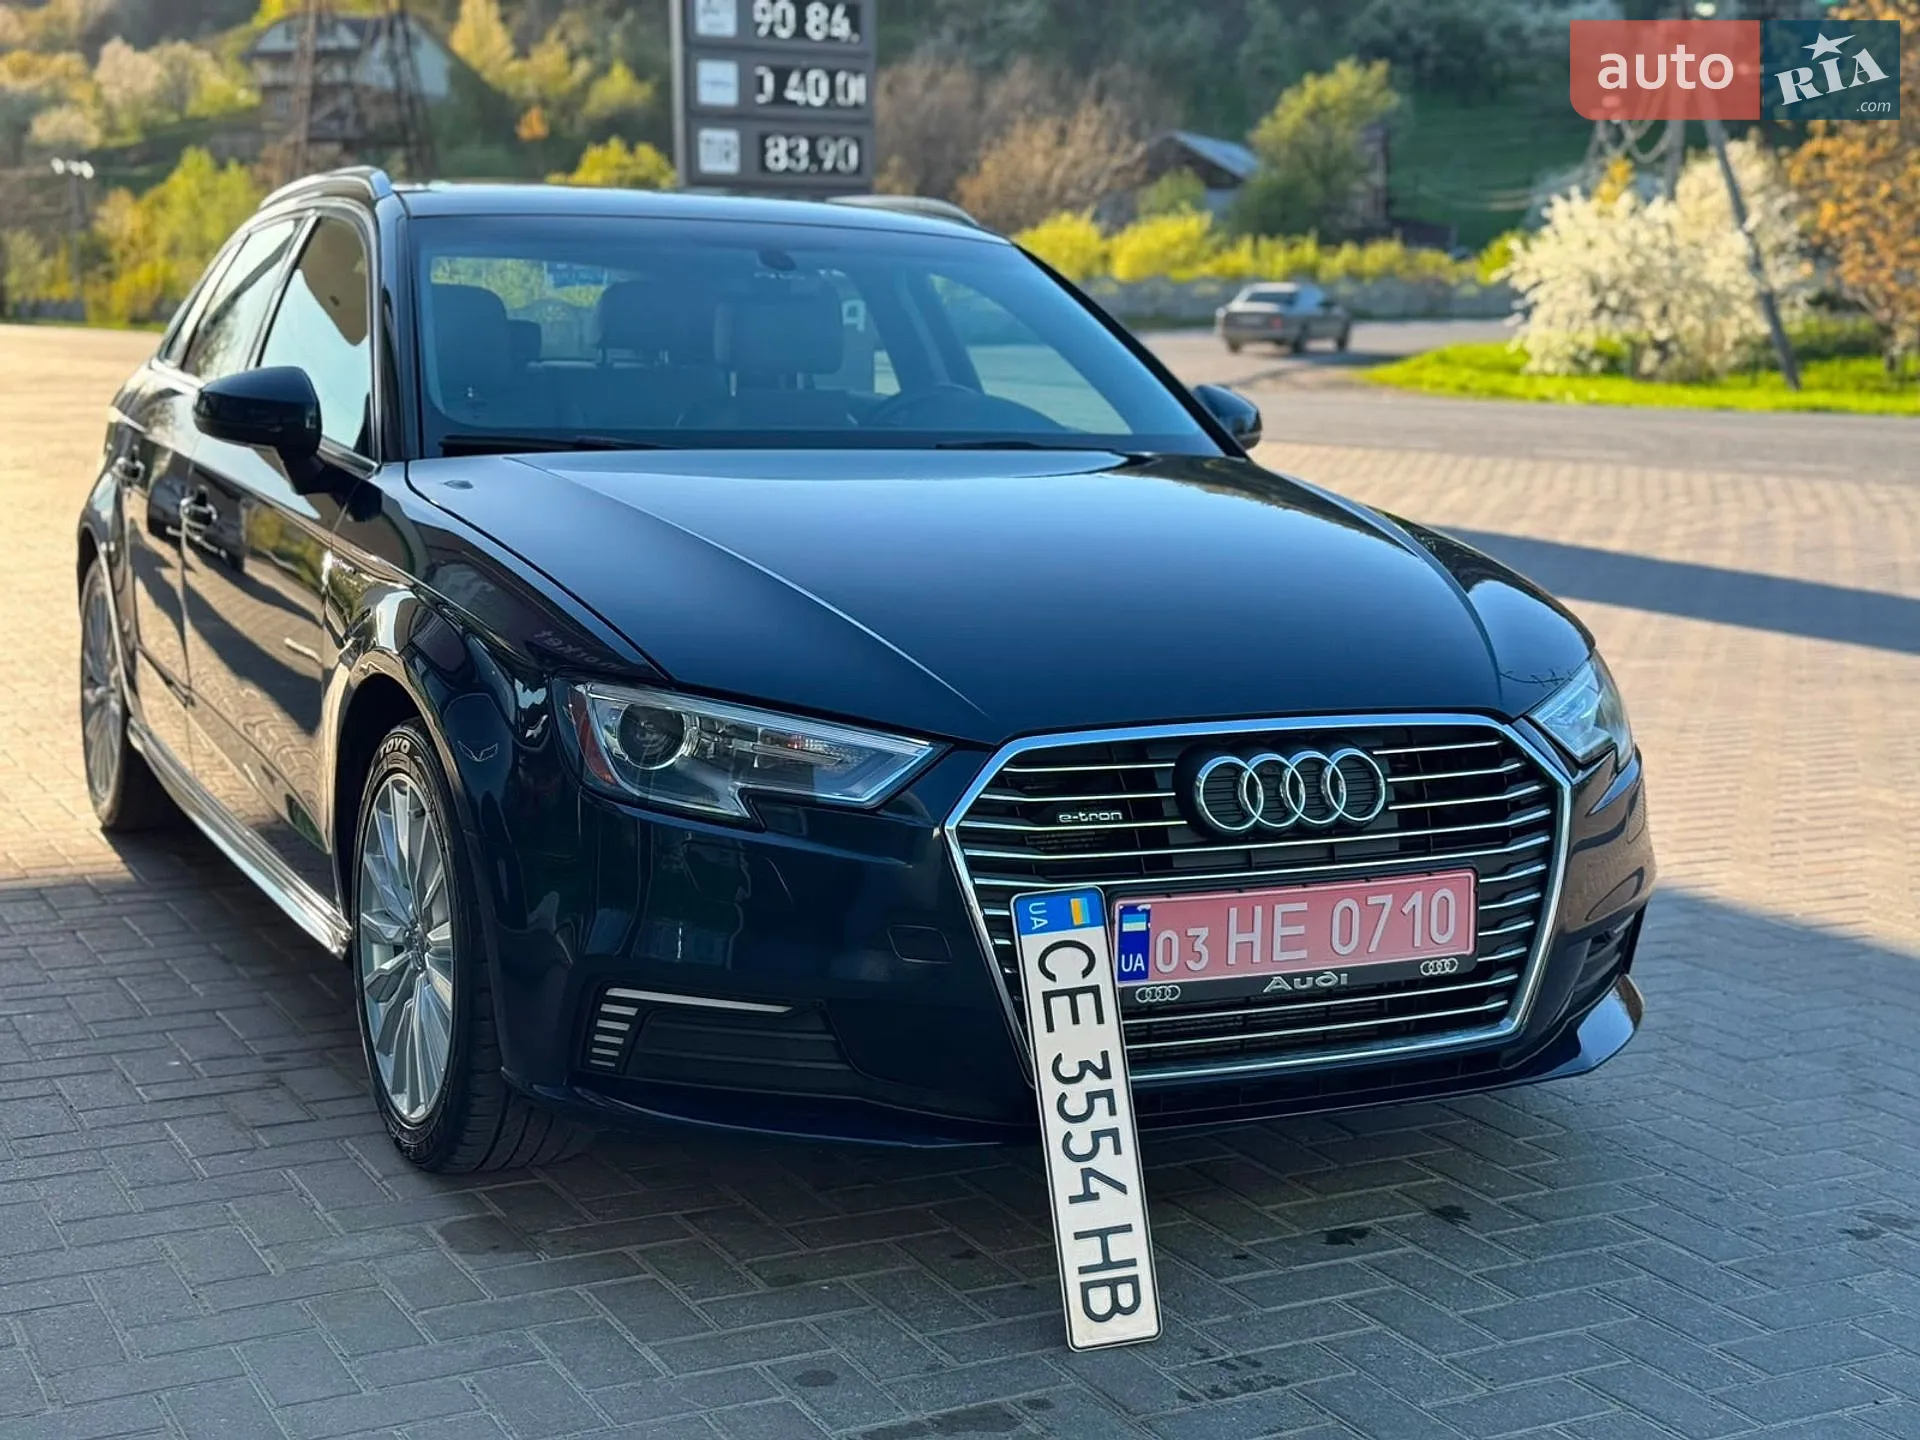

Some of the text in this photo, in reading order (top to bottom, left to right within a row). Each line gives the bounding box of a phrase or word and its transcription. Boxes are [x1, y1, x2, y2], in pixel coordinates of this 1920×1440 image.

[765, 134, 859, 173] 83.90
[1058, 811, 1123, 823] e-tron
[1028, 902, 1049, 930] UA
[1155, 887, 1455, 974] 03 HE 0710
[1121, 952, 1146, 972] UA
[1262, 970, 1349, 994] Audi
[1038, 939, 1142, 1323] CE 3554 HB
